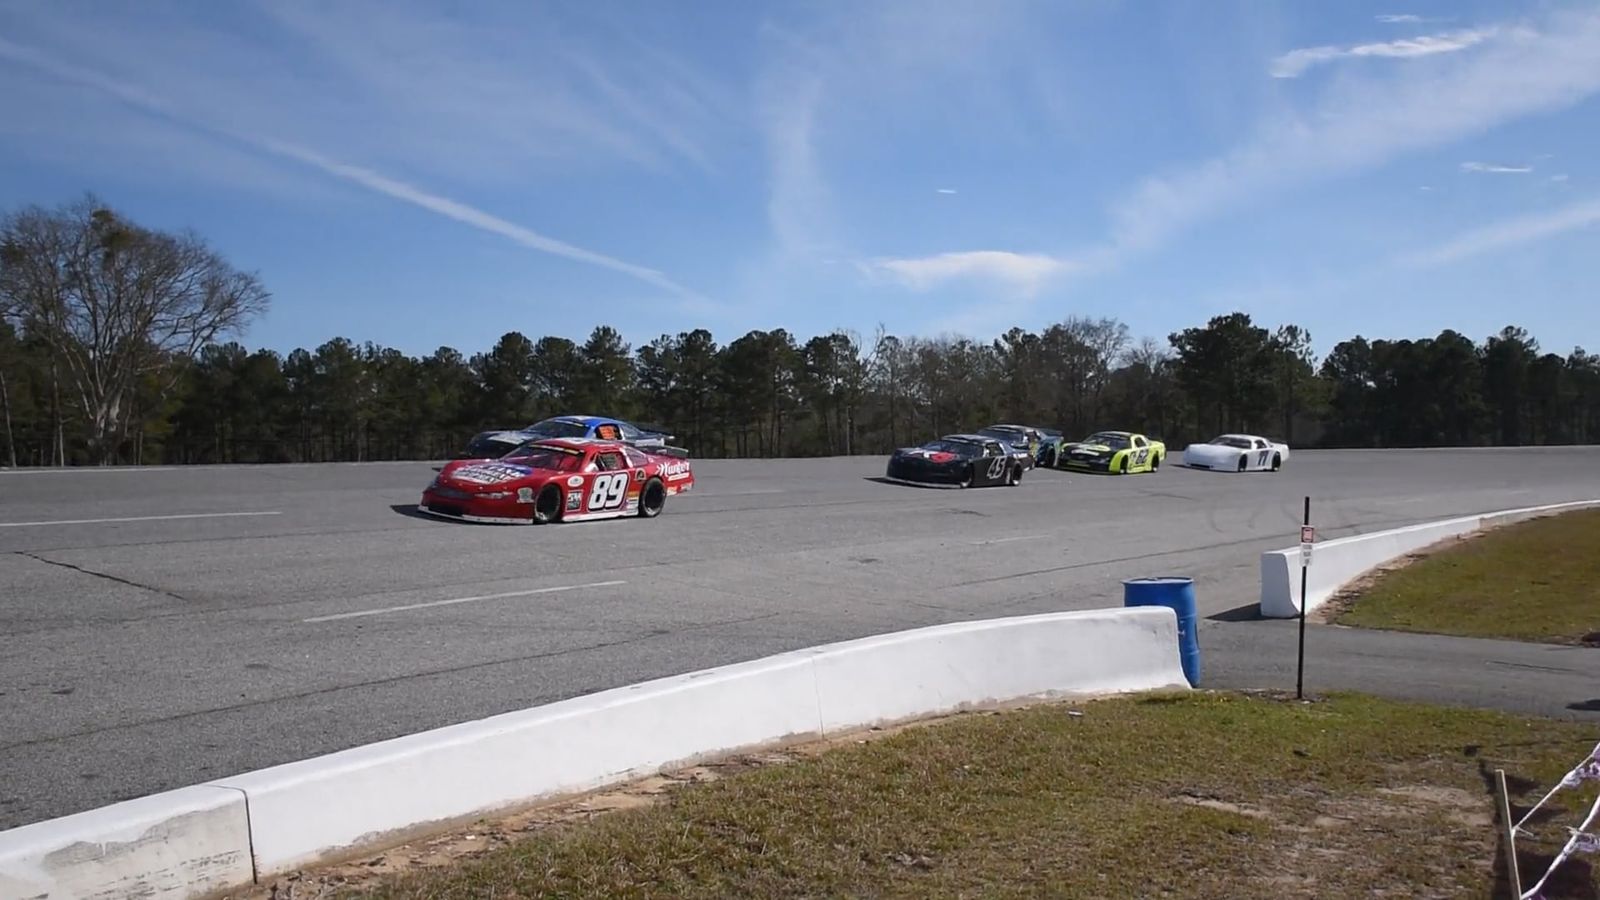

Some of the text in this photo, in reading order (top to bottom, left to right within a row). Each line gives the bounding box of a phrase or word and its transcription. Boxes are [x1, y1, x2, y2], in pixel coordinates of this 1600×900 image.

[987, 455, 1007, 479] 45
[1257, 450, 1269, 466] 77
[588, 473, 628, 509] 89
